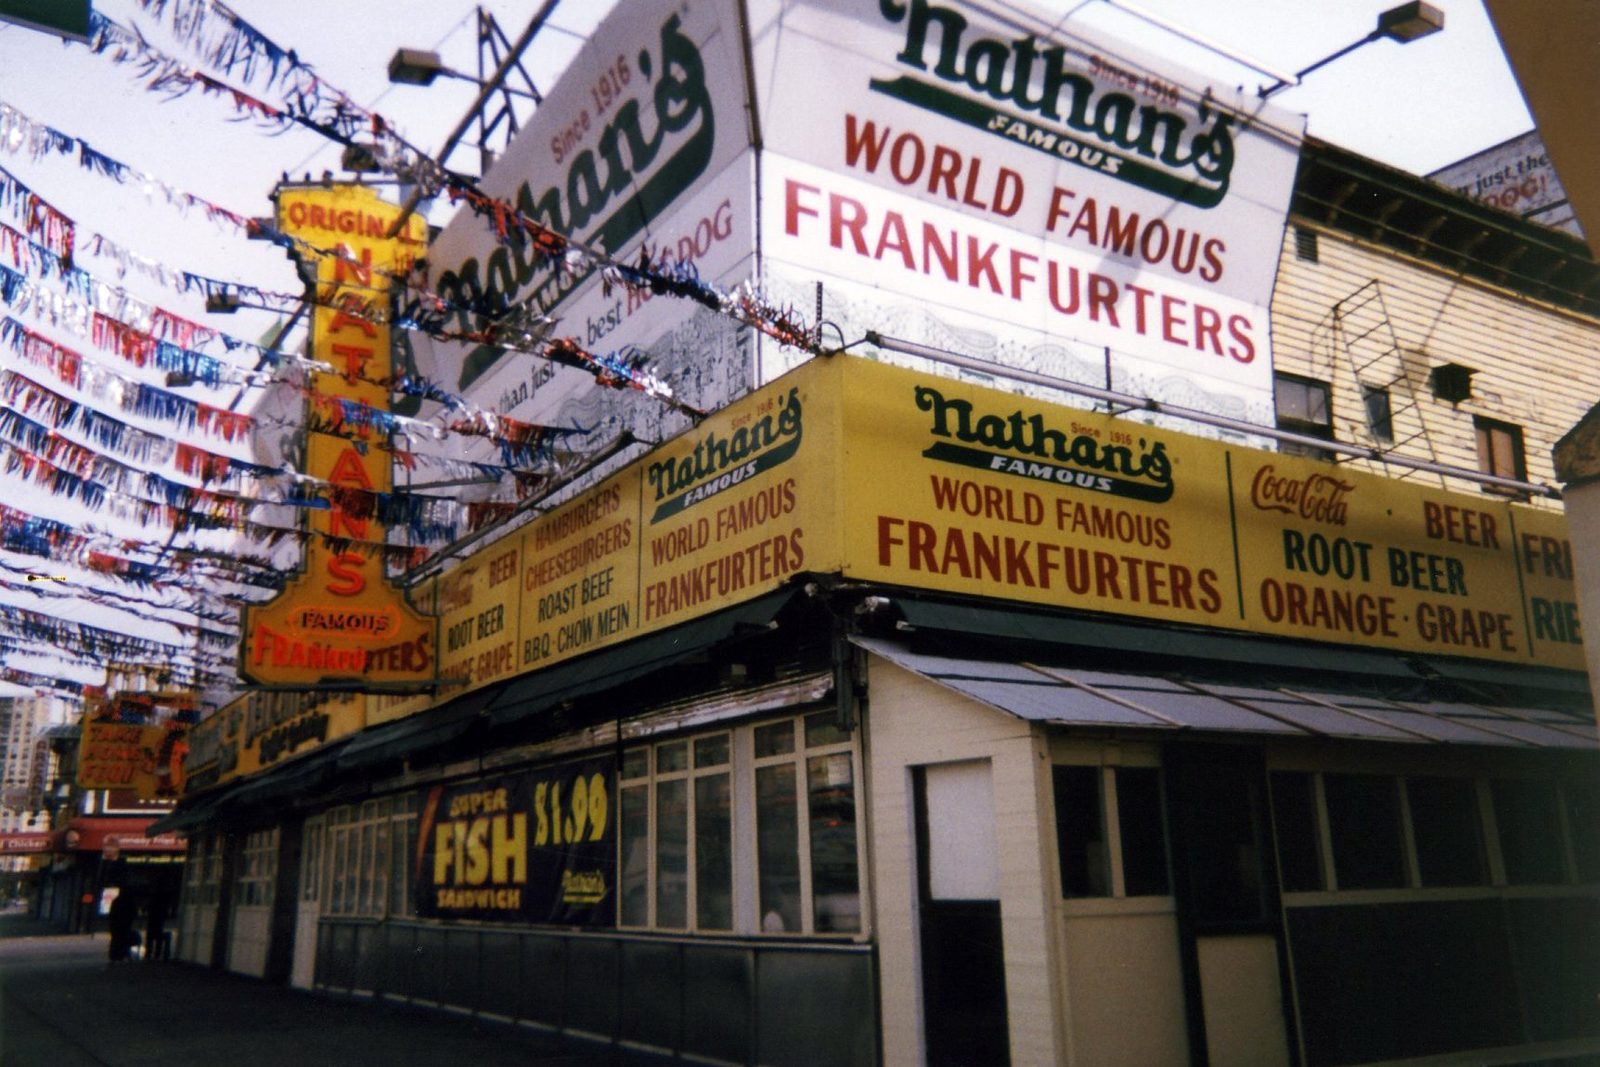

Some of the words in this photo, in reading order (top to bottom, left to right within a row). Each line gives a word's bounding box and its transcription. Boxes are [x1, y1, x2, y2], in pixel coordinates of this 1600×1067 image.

[551, 108, 591, 165] Since
[591, 54, 631, 115] 1916
[987, 113, 1124, 176] FAMOUS
[288, 201, 413, 241] ORIGINL
[845, 113, 1025, 218] WORLD
[1046, 186, 1227, 284] FAMOUS
[784, 178, 1257, 365] FRANKFURTERS
[587, 300, 623, 347] best
[648, 386, 803, 502] Nathan's
[914, 386, 1173, 484] Nathan's
[1070, 421, 1100, 439] Since
[1108, 430, 1133, 446] 1916
[683, 459, 758, 508] FAMOUS
[990, 455, 1114, 492] FAMOUS
[1251, 464, 1356, 526] Coca-Cola
[1423, 500, 1500, 550] BEER
[535, 483, 621, 552] HAMBURGERS
[651, 517, 710, 568] WORLD
[716, 477, 796, 542] FAMOUS
[930, 475, 1045, 526] WORLD
[1055, 498, 1172, 550] FAMOUS
[489, 549, 518, 589] BEER
[525, 518, 632, 592] CHEESEBURGERS
[645, 527, 804, 622] FRANKFURTERS
[877, 515, 1223, 615] FRANKFURTERS
[1282, 529, 1374, 583] ROOT
[1387, 547, 1468, 597] BEER
[301, 611, 389, 635] FAMOUS
[448, 617, 475, 654] ROOT
[477, 604, 504, 640] BEER
[538, 583, 578, 623] ROAST
[581, 566, 615, 606] BEEF
[557, 615, 594, 653] CHOW
[597, 600, 630, 637] MEIN
[1260, 577, 1400, 638] ORANGE
[1416, 602, 1518, 653] GRAPE
[534, 772, 608, 847] $1.99
[432, 812, 528, 886] FISH
[436, 887, 521, 910] SANDWICH
